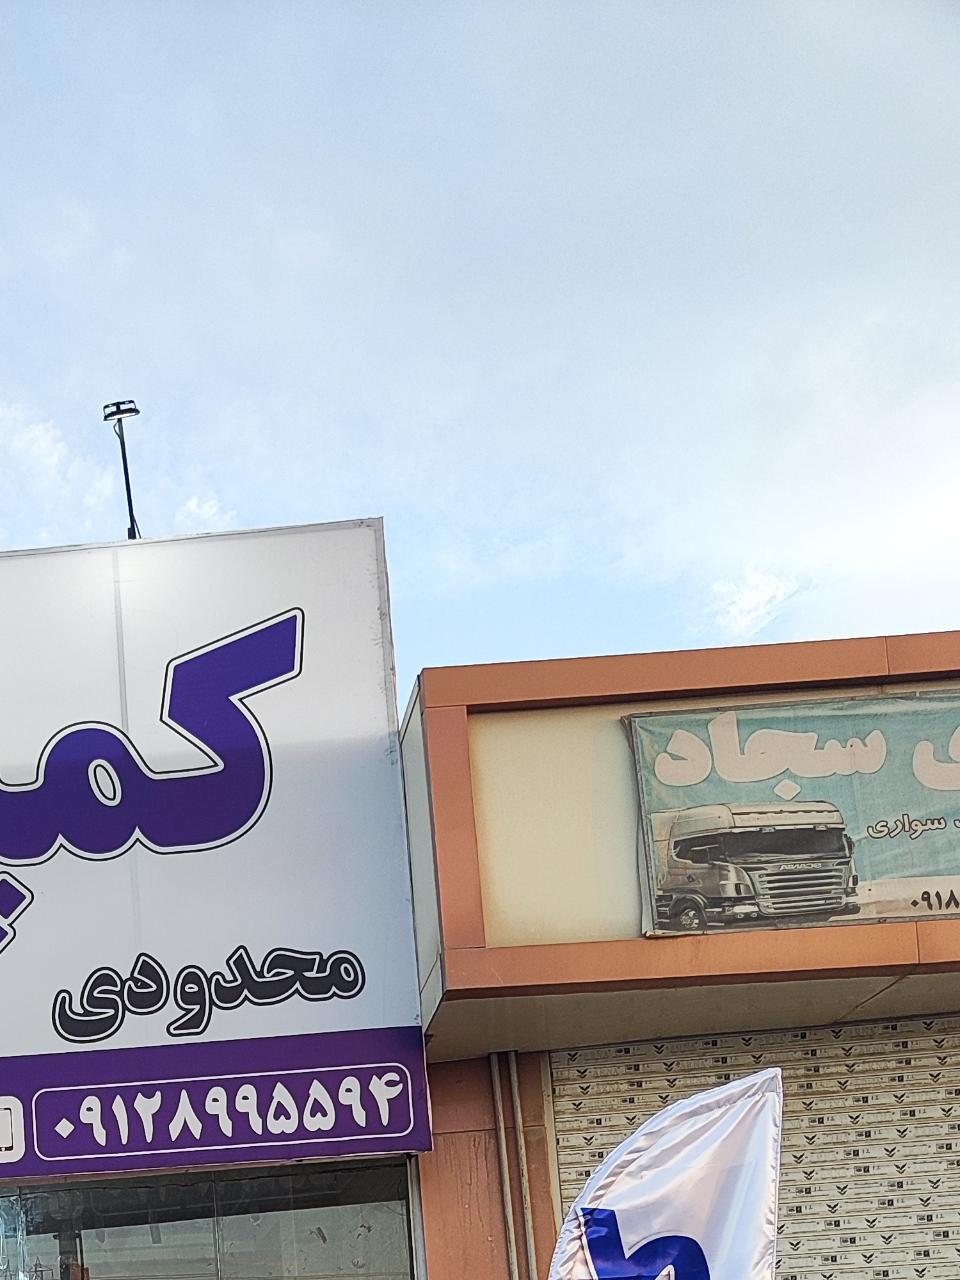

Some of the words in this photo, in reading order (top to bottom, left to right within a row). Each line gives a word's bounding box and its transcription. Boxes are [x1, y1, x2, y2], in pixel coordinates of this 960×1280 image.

[654, 711, 887, 801] سجاد
[867, 813, 947, 840] سواری
[52, 945, 366, 1044] محدودی
[54, 1072, 404, 1147] ۰۹۱۲۸۹۹۵۵۹۴
